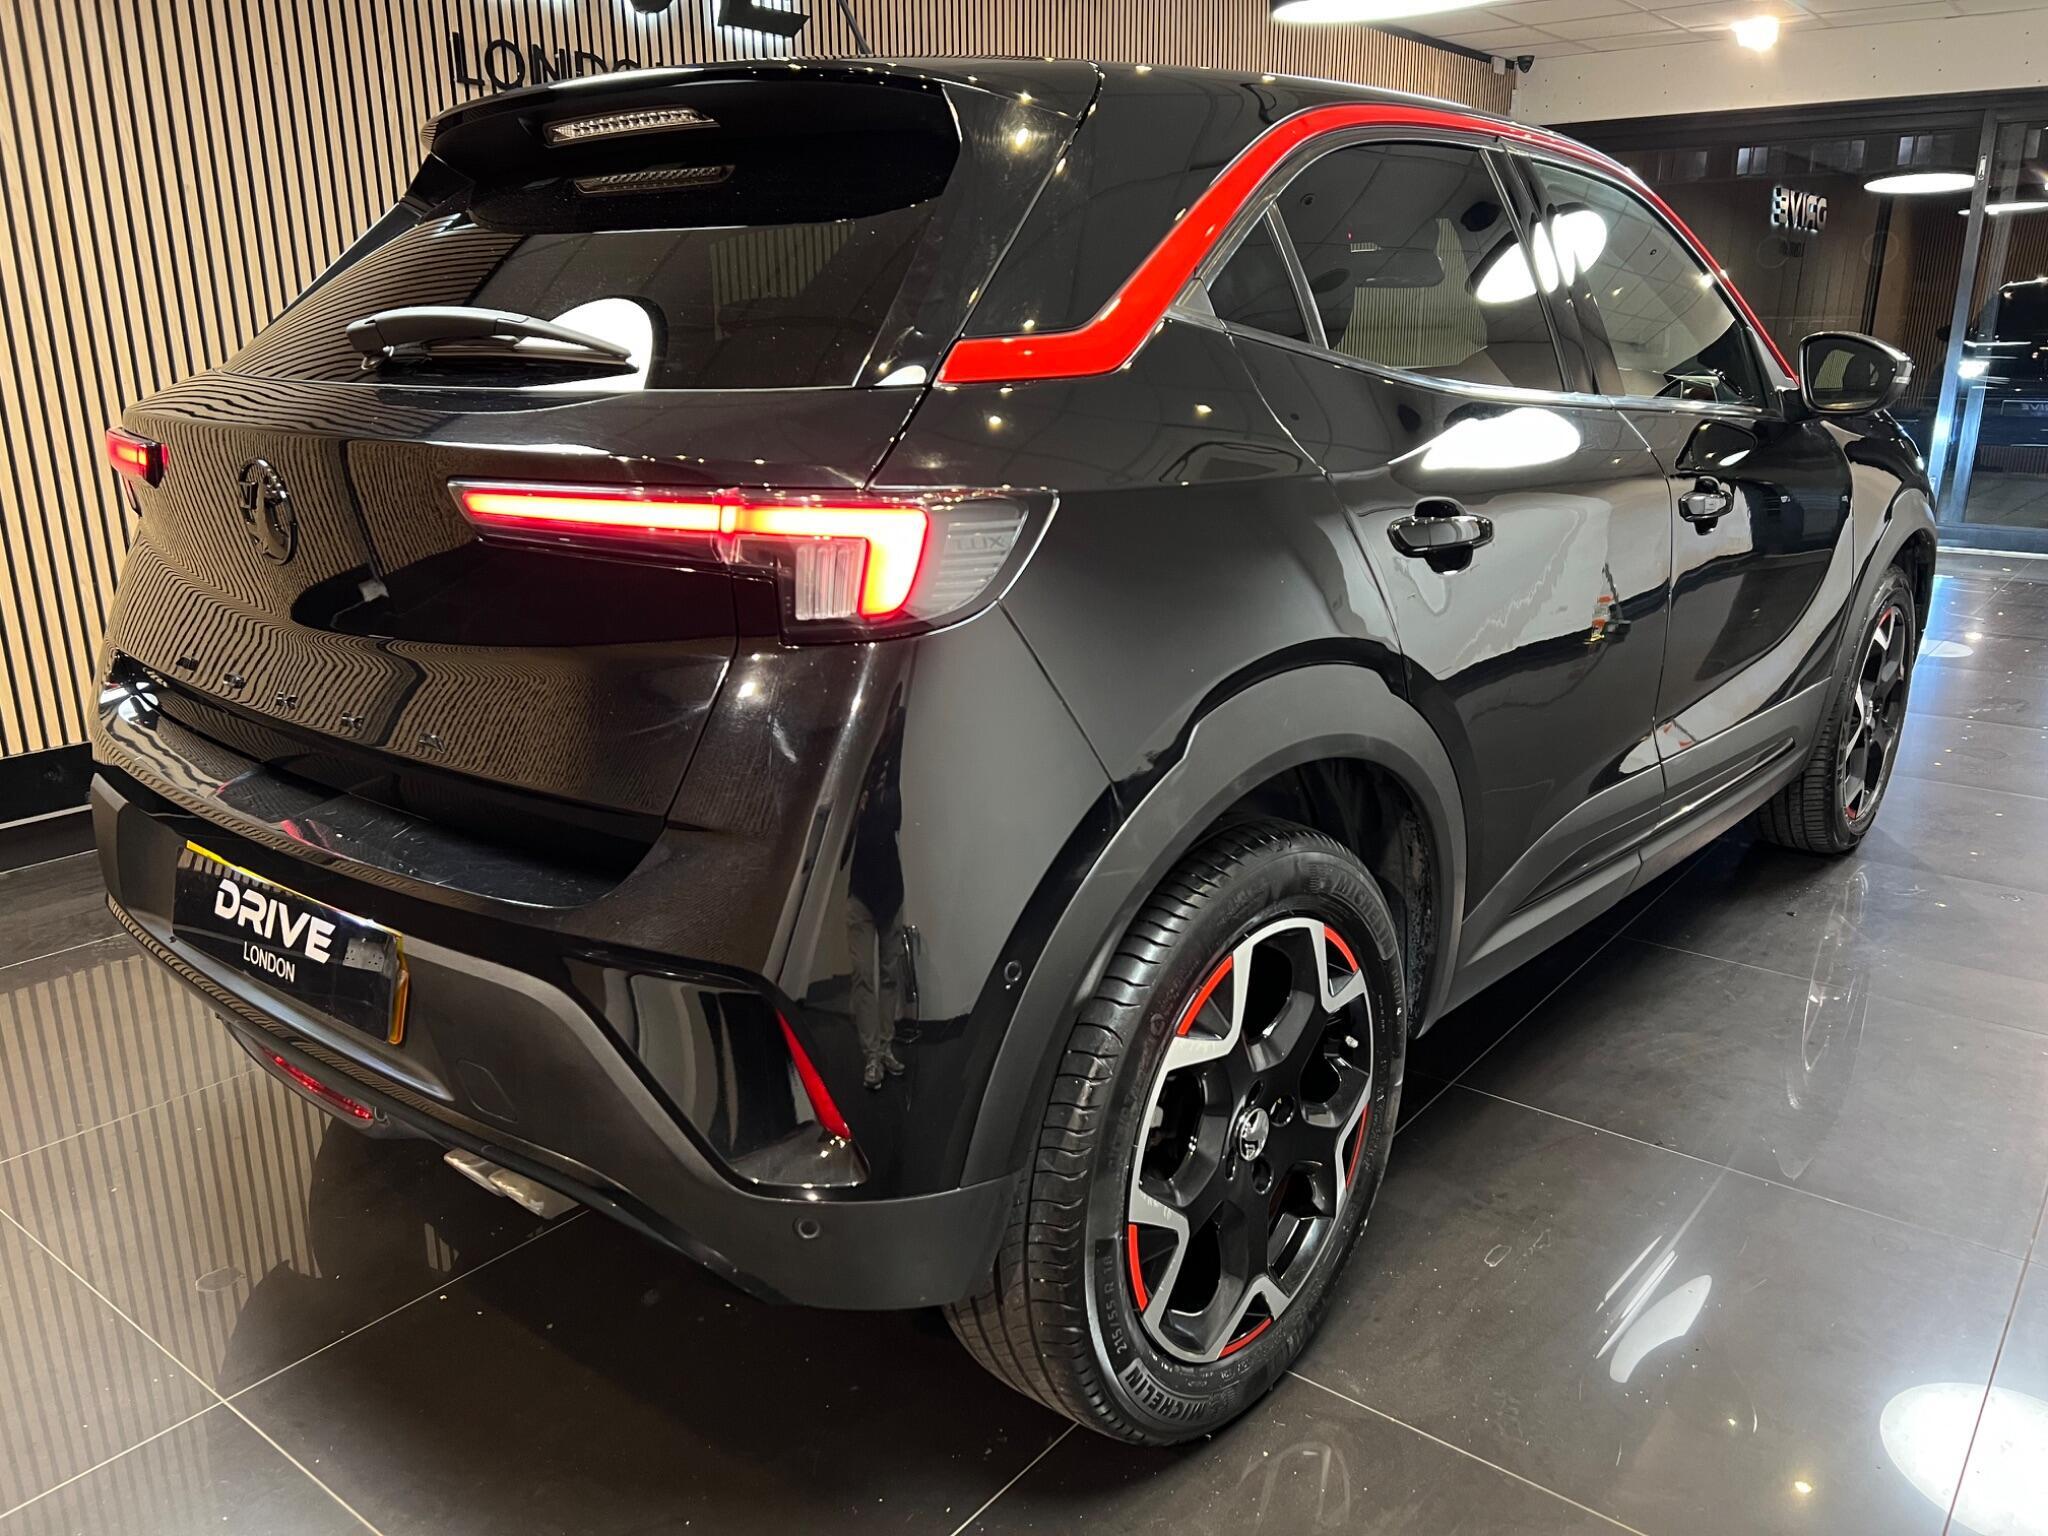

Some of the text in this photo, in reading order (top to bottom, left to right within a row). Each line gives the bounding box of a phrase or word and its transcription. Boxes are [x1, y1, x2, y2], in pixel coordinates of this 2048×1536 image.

[214, 878, 336, 964] DRIVE
[243, 940, 295, 982] LONDON
[1106, 1300, 1128, 1354] 215/55
[1125, 1366, 1204, 1421] MICHELIN
